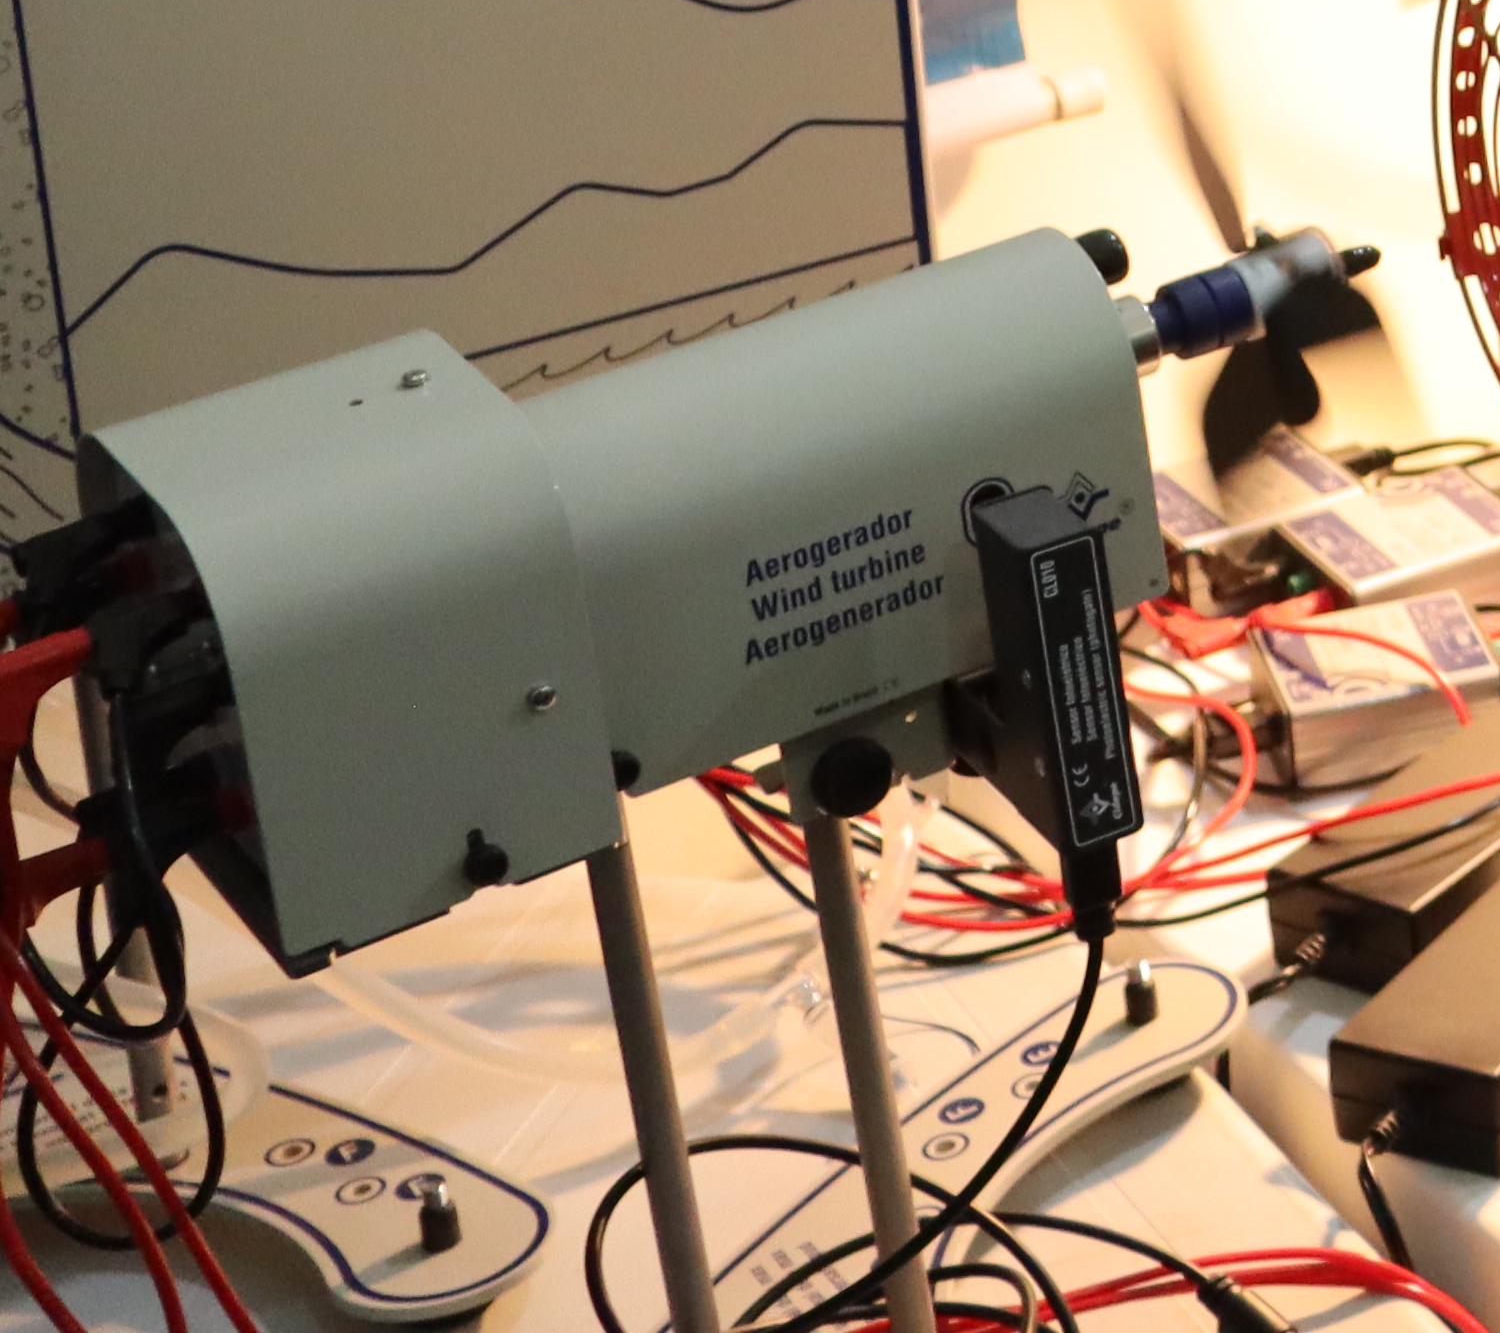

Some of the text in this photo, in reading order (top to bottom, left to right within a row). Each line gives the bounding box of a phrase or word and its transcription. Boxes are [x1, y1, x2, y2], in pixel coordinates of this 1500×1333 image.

[745, 508, 913, 588] Aerogerador
[751, 543, 926, 623] Wind turbine
[744, 574, 945, 666] Aerogenerador
[1083, 704, 1098, 743] Sensor
